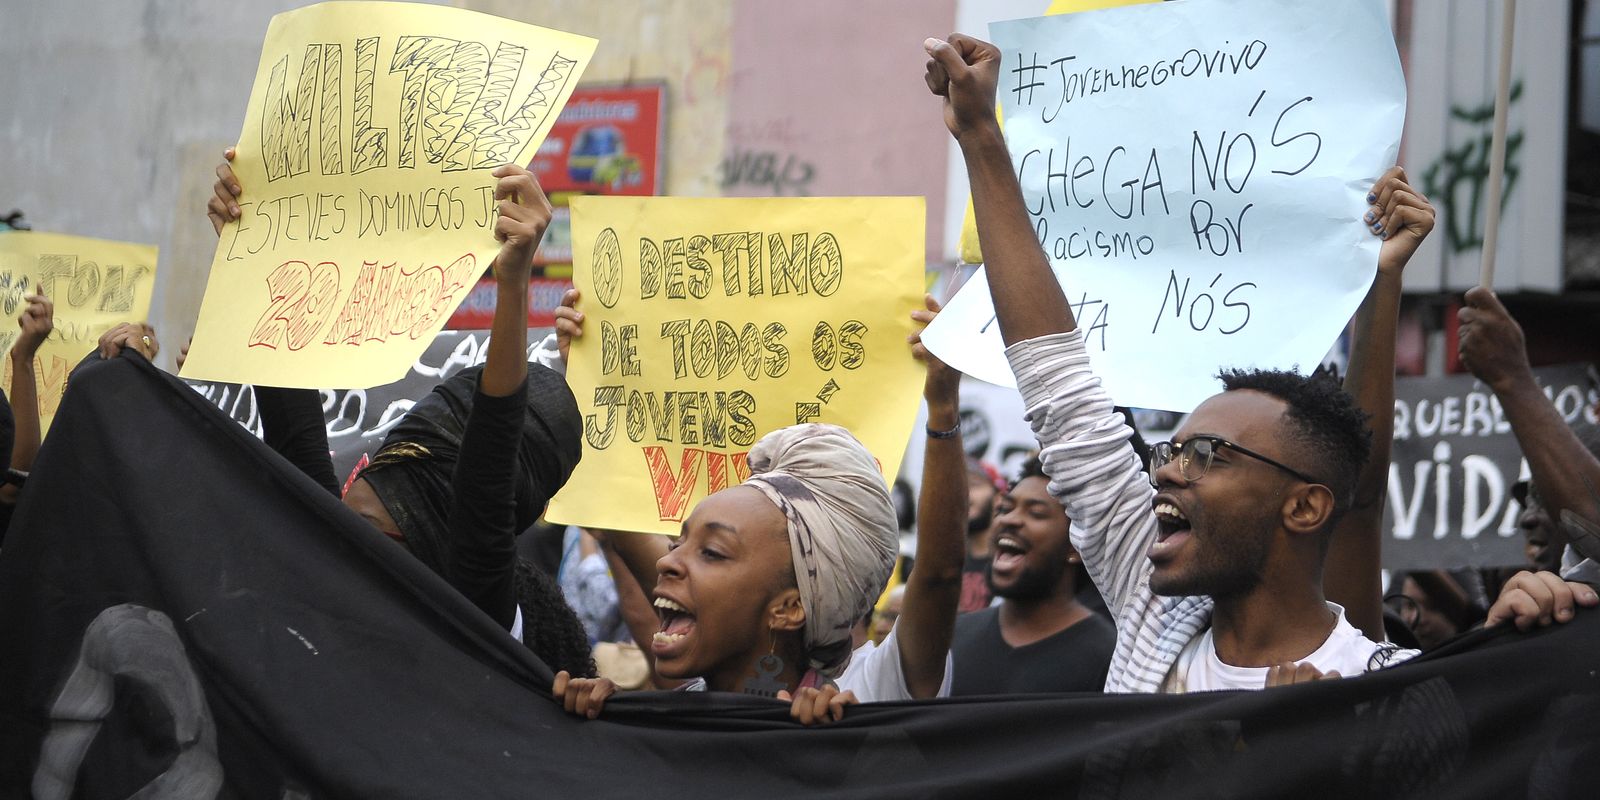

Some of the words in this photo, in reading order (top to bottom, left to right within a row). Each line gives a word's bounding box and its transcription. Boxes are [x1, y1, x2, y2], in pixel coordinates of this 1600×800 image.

[261, 36, 577, 182] WILTON
[1192, 90, 1321, 194] NÓS
[226, 192, 347, 261] ESTEVES
[357, 185, 464, 239] DOMINGOS
[248, 260, 341, 351] 20
[592, 227, 623, 309] O
[640, 232, 843, 299] DESTINO
[1152, 269, 1257, 335] NÓS
[600, 320, 642, 377] DE
[661, 319, 790, 380] TODOS
[811, 320, 868, 371] OS
[586, 385, 756, 450] JOVENS
